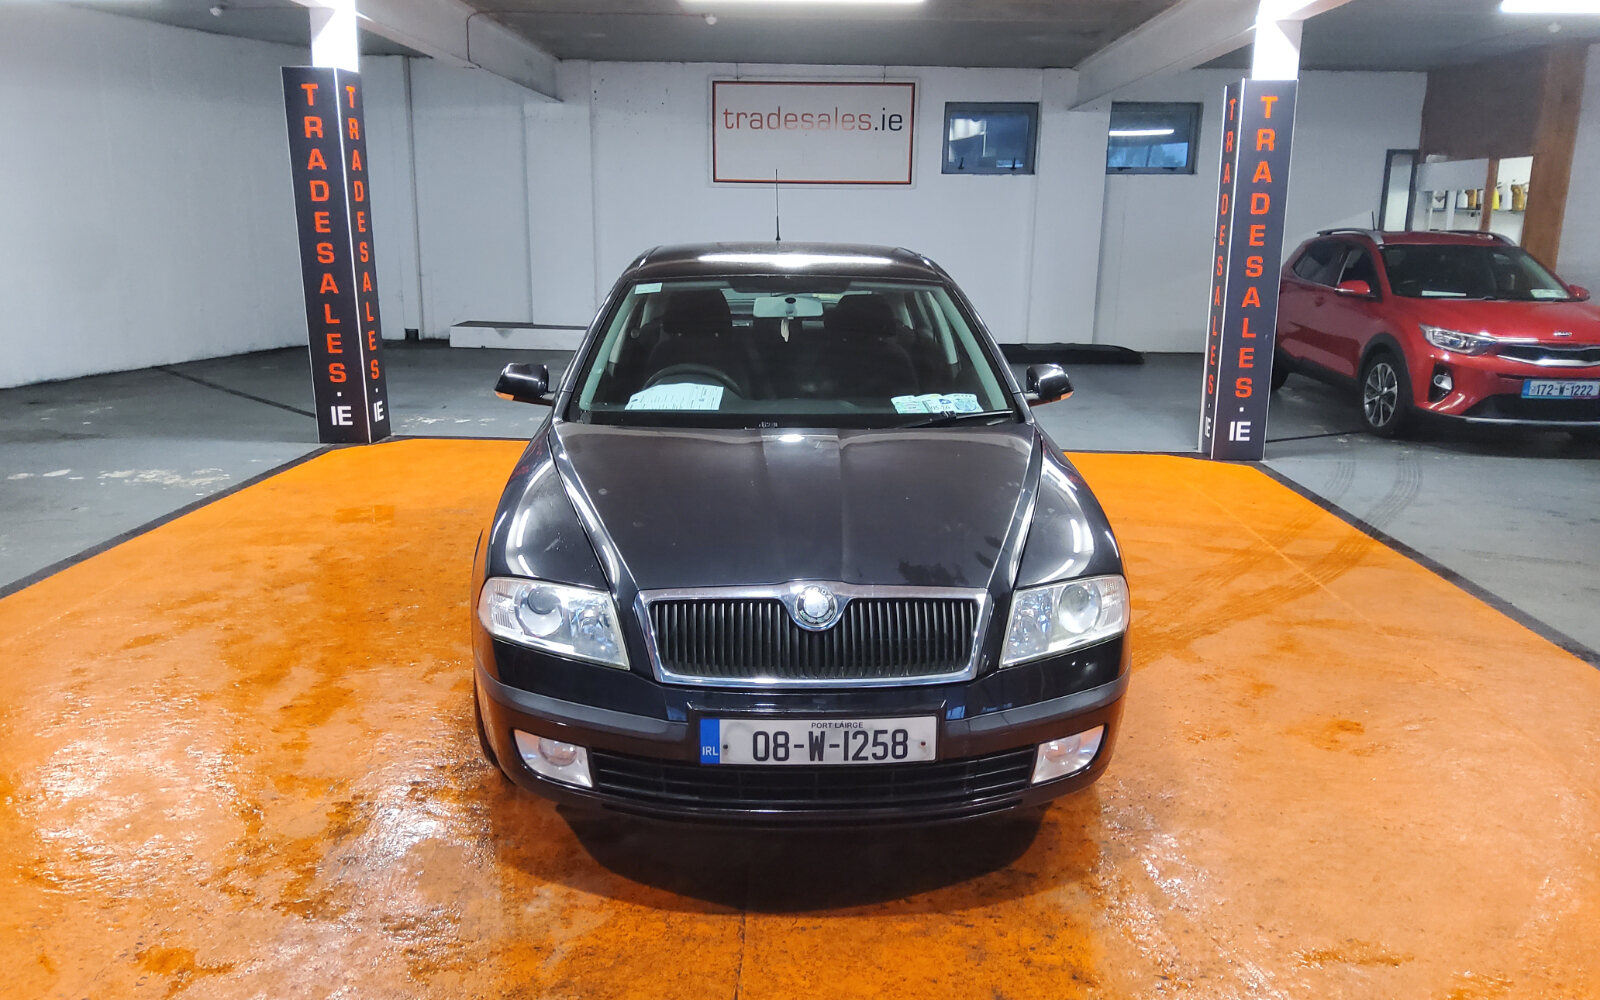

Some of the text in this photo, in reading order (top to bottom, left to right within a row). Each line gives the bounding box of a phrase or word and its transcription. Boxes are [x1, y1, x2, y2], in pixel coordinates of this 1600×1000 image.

[723, 105, 903, 132] tradesales.ie
[1536, 384, 1594, 396] 172-W-1222
[702, 746, 719, 756] IRL
[752, 729, 909, 762] 08-W-1258
